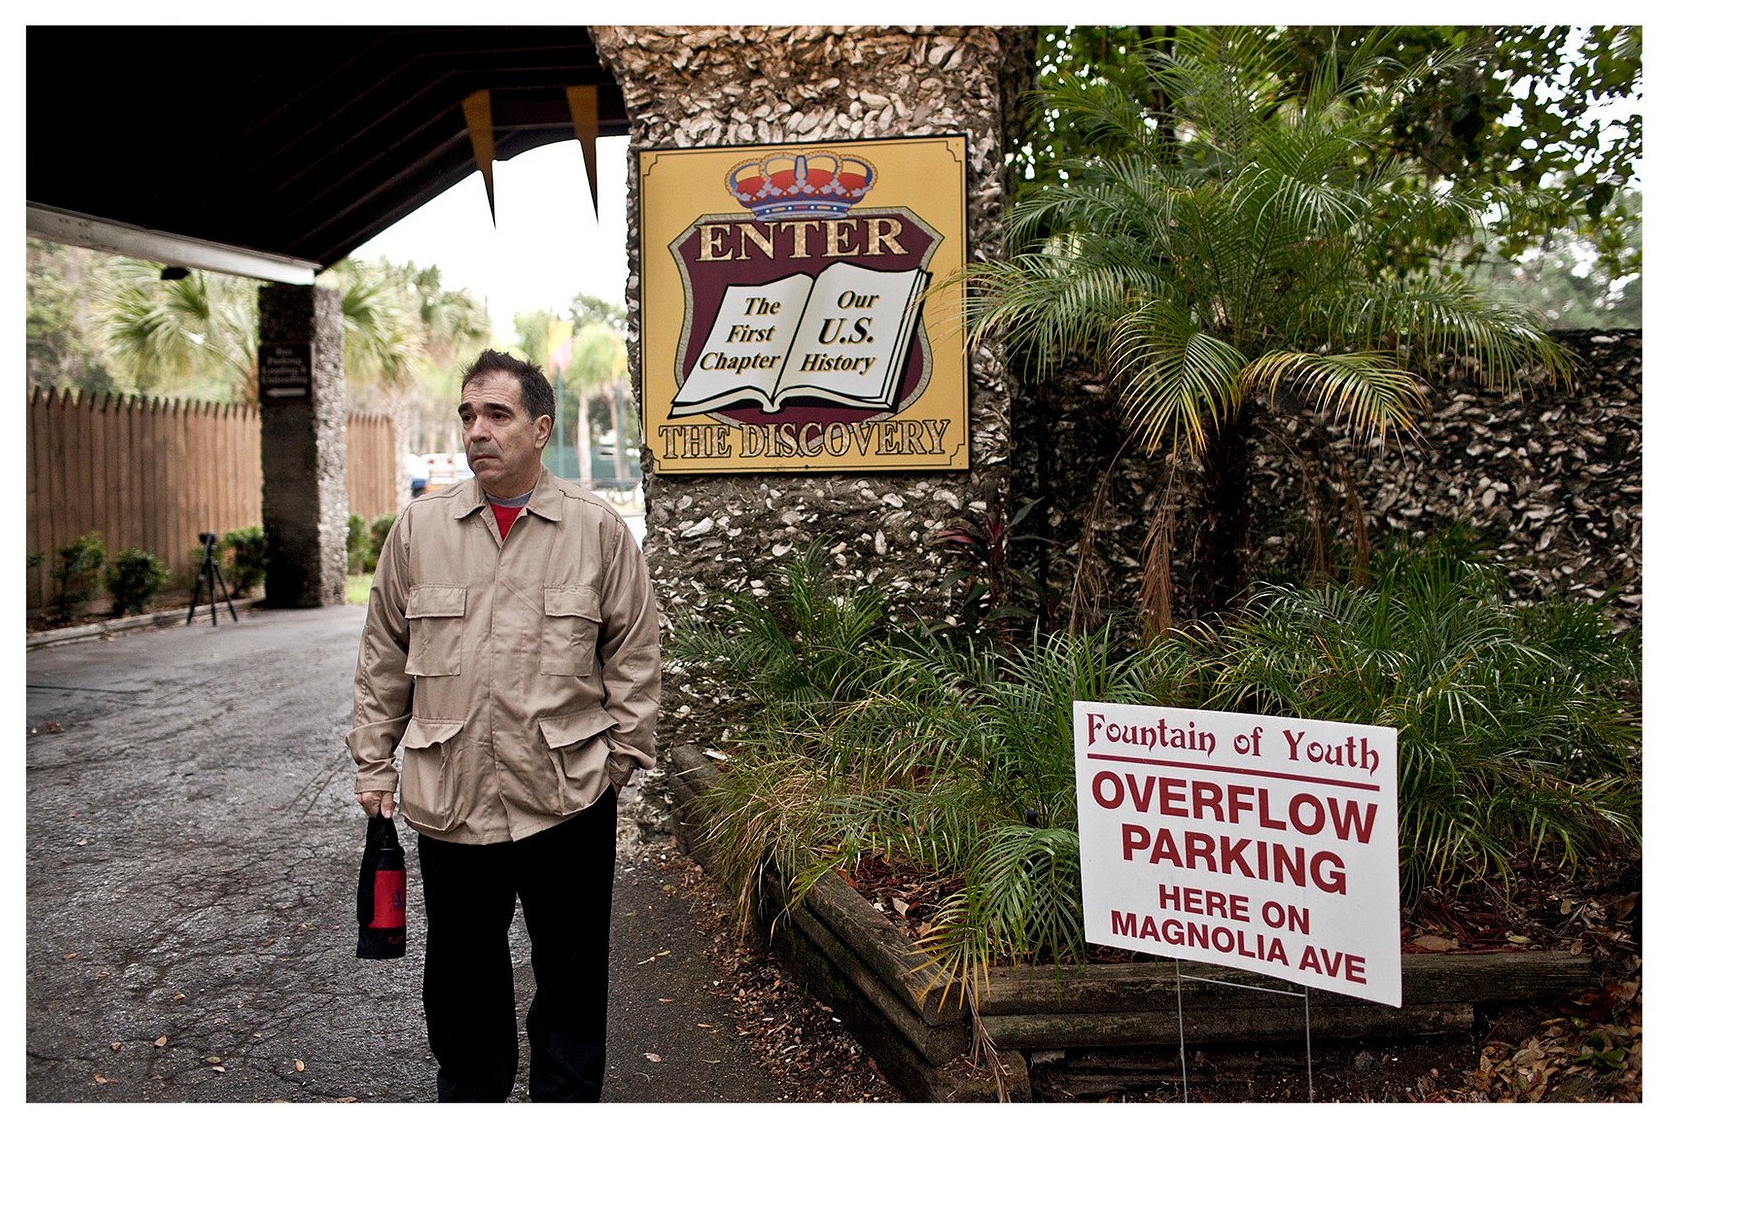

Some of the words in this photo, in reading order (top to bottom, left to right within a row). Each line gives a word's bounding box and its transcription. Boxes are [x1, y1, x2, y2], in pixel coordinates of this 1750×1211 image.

[695, 217, 908, 262] ENTER
[743, 297, 782, 316] The
[837, 290, 880, 309] Our
[725, 324, 776, 343] First
[817, 317, 875, 345] U.S.
[699, 351, 781, 374] Chapter
[799, 352, 876, 375] History
[659, 423, 732, 459] THE
[739, 419, 951, 458] DISCOVERY
[1086, 712, 1216, 758] Fountain
[1233, 727, 1264, 757] of
[1282, 729, 1380, 776] Youth
[1091, 770, 1378, 844] OVERFLOW
[1121, 823, 1347, 895] PARKING
[1159, 884, 1250, 923] HERE
[1262, 901, 1310, 935] ON
[1111, 910, 1289, 967] MAGNOLIA
[1298, 945, 1367, 985] AVE
